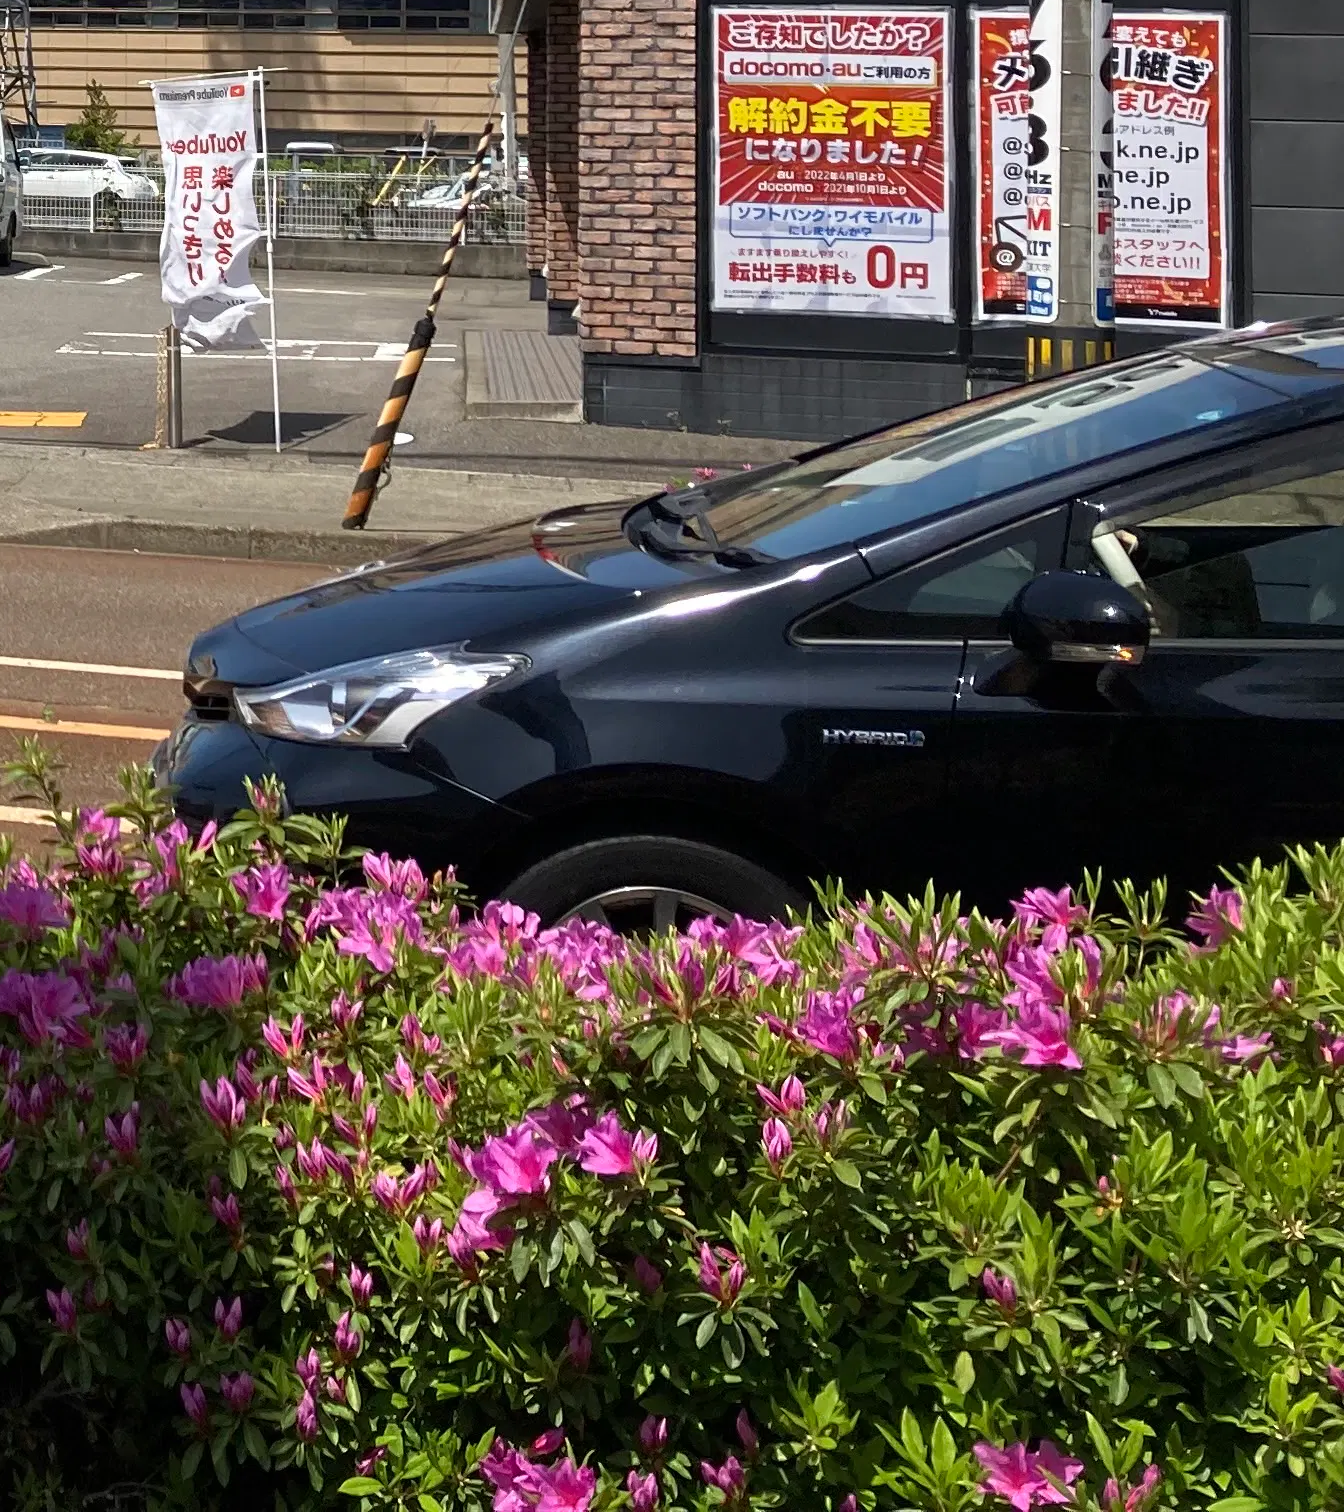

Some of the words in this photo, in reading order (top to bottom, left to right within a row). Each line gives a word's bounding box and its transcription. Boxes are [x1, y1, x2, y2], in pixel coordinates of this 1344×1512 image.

[1113, 25, 1186, 48] 変えても
[727, 97, 932, 138] 解約金不要
[1113, 125, 1175, 136] アドレス例
[777, 171, 795, 181] au
[758, 181, 813, 193] docomo
[728, 261, 857, 285] 転出手数料も
[822, 728, 908, 746] HYBRID
